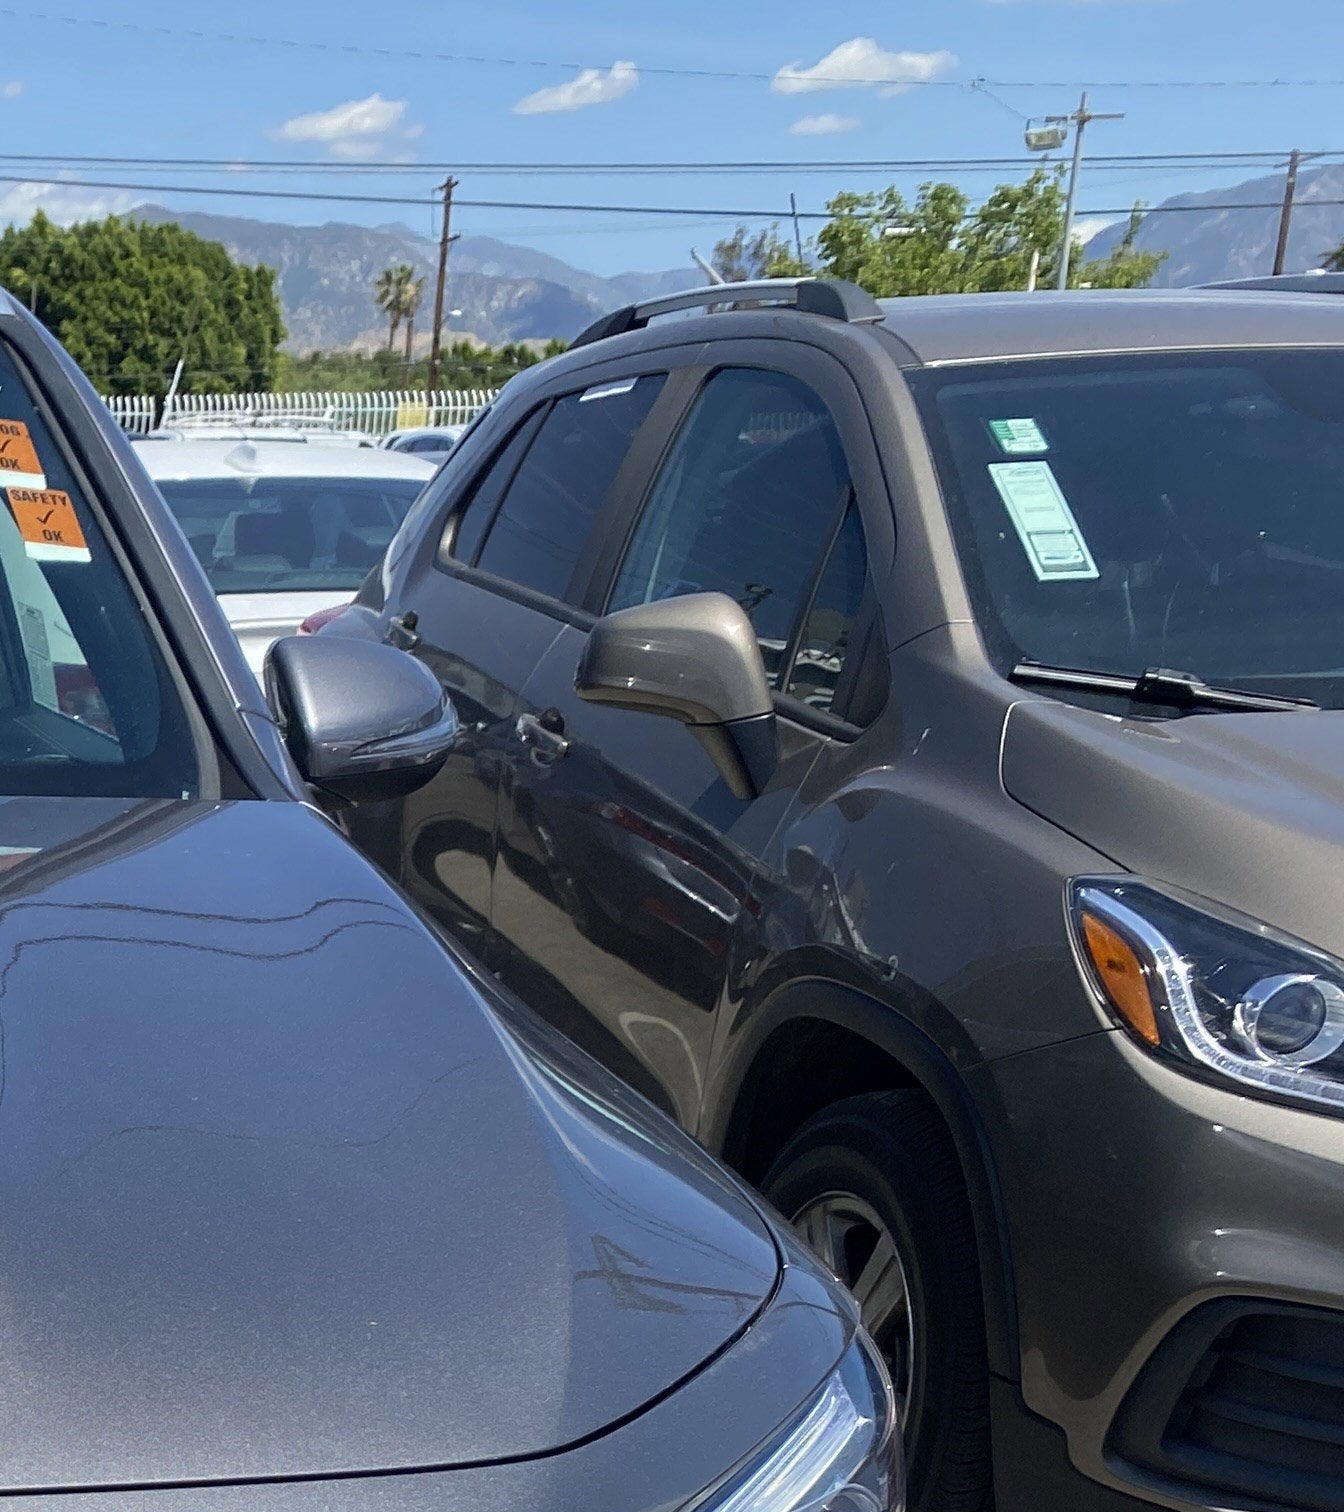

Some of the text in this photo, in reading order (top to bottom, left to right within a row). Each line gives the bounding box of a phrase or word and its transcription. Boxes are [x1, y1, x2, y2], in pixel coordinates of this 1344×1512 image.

[0, 457, 20, 470] OK
[9, 490, 67, 507] SAFETY
[42, 529, 64, 543] OK
